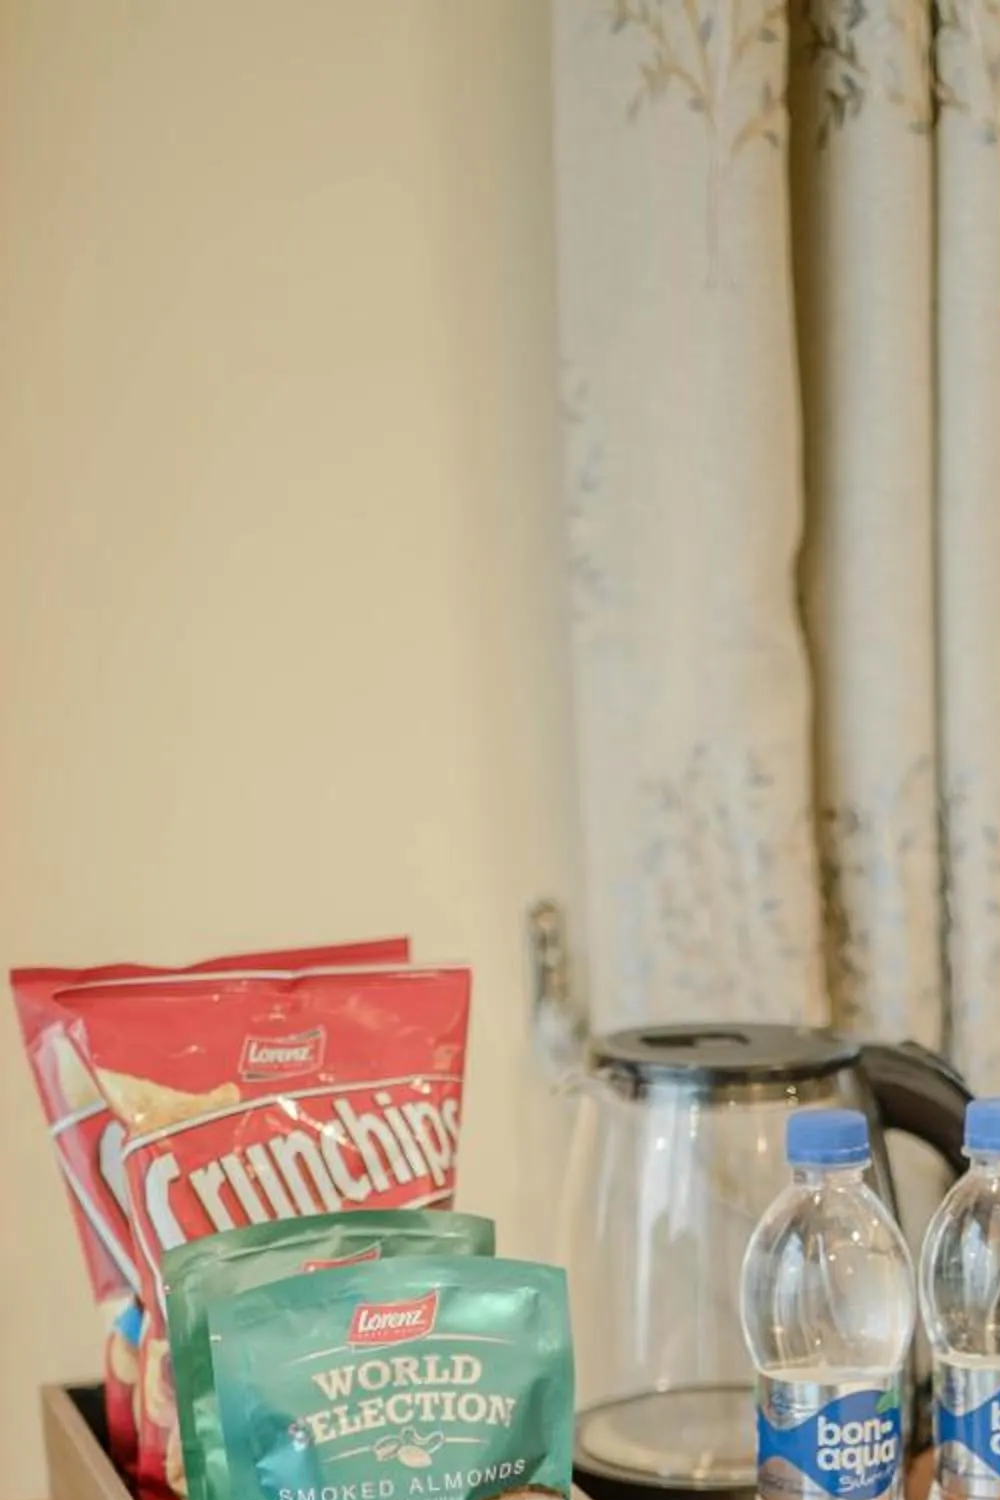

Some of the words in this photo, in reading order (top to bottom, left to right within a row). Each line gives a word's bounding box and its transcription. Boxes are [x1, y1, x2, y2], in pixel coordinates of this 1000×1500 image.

[358, 1308, 424, 1333] Lorenz
[311, 1354, 482, 1400] WORLD
[817, 1437, 897, 1475] aqua
[409, 1459, 526, 1496] ALMONDS
